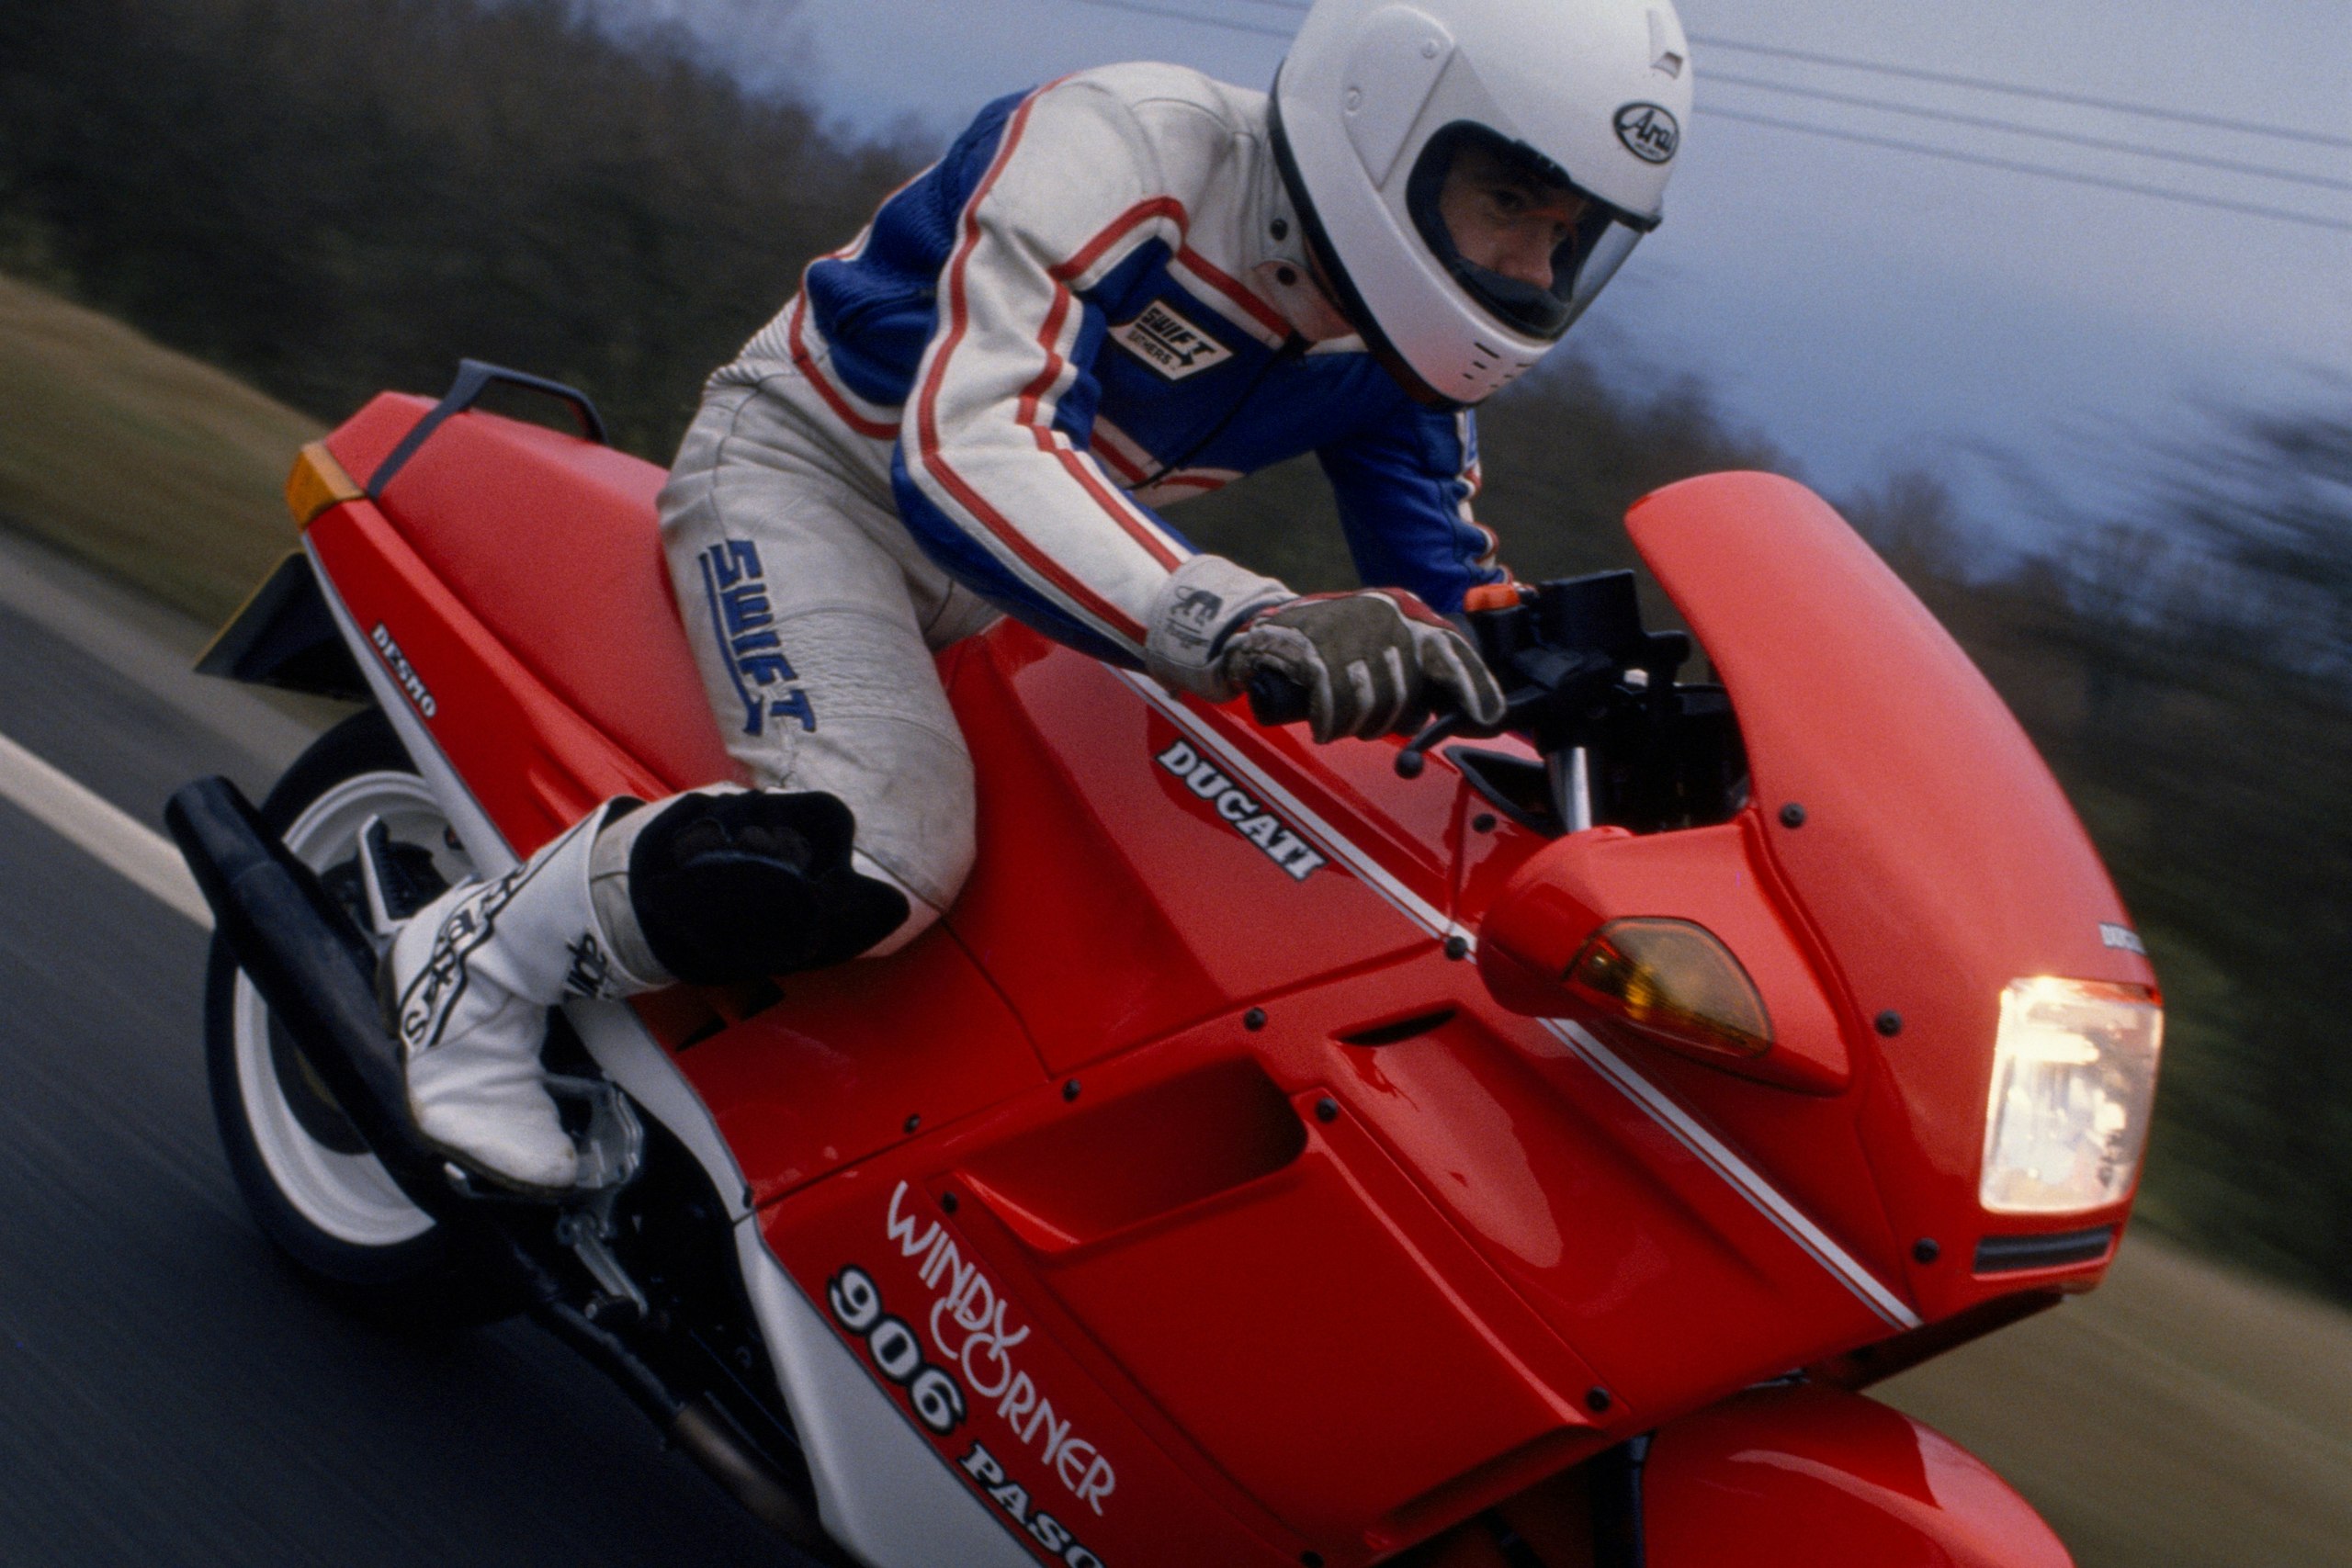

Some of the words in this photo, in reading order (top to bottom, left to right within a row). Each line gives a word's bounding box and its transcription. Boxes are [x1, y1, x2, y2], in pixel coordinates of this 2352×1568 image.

[1141, 306, 1217, 355] SWIFT
[371, 621, 437, 718] DESMO
[707, 538, 817, 733] SWIFT
[1155, 739, 1329, 882] DUCATI
[828, 1264, 967, 1435] 906
[887, 1179, 1031, 1361] WINDY
[930, 1296, 1115, 1517] CORNER
